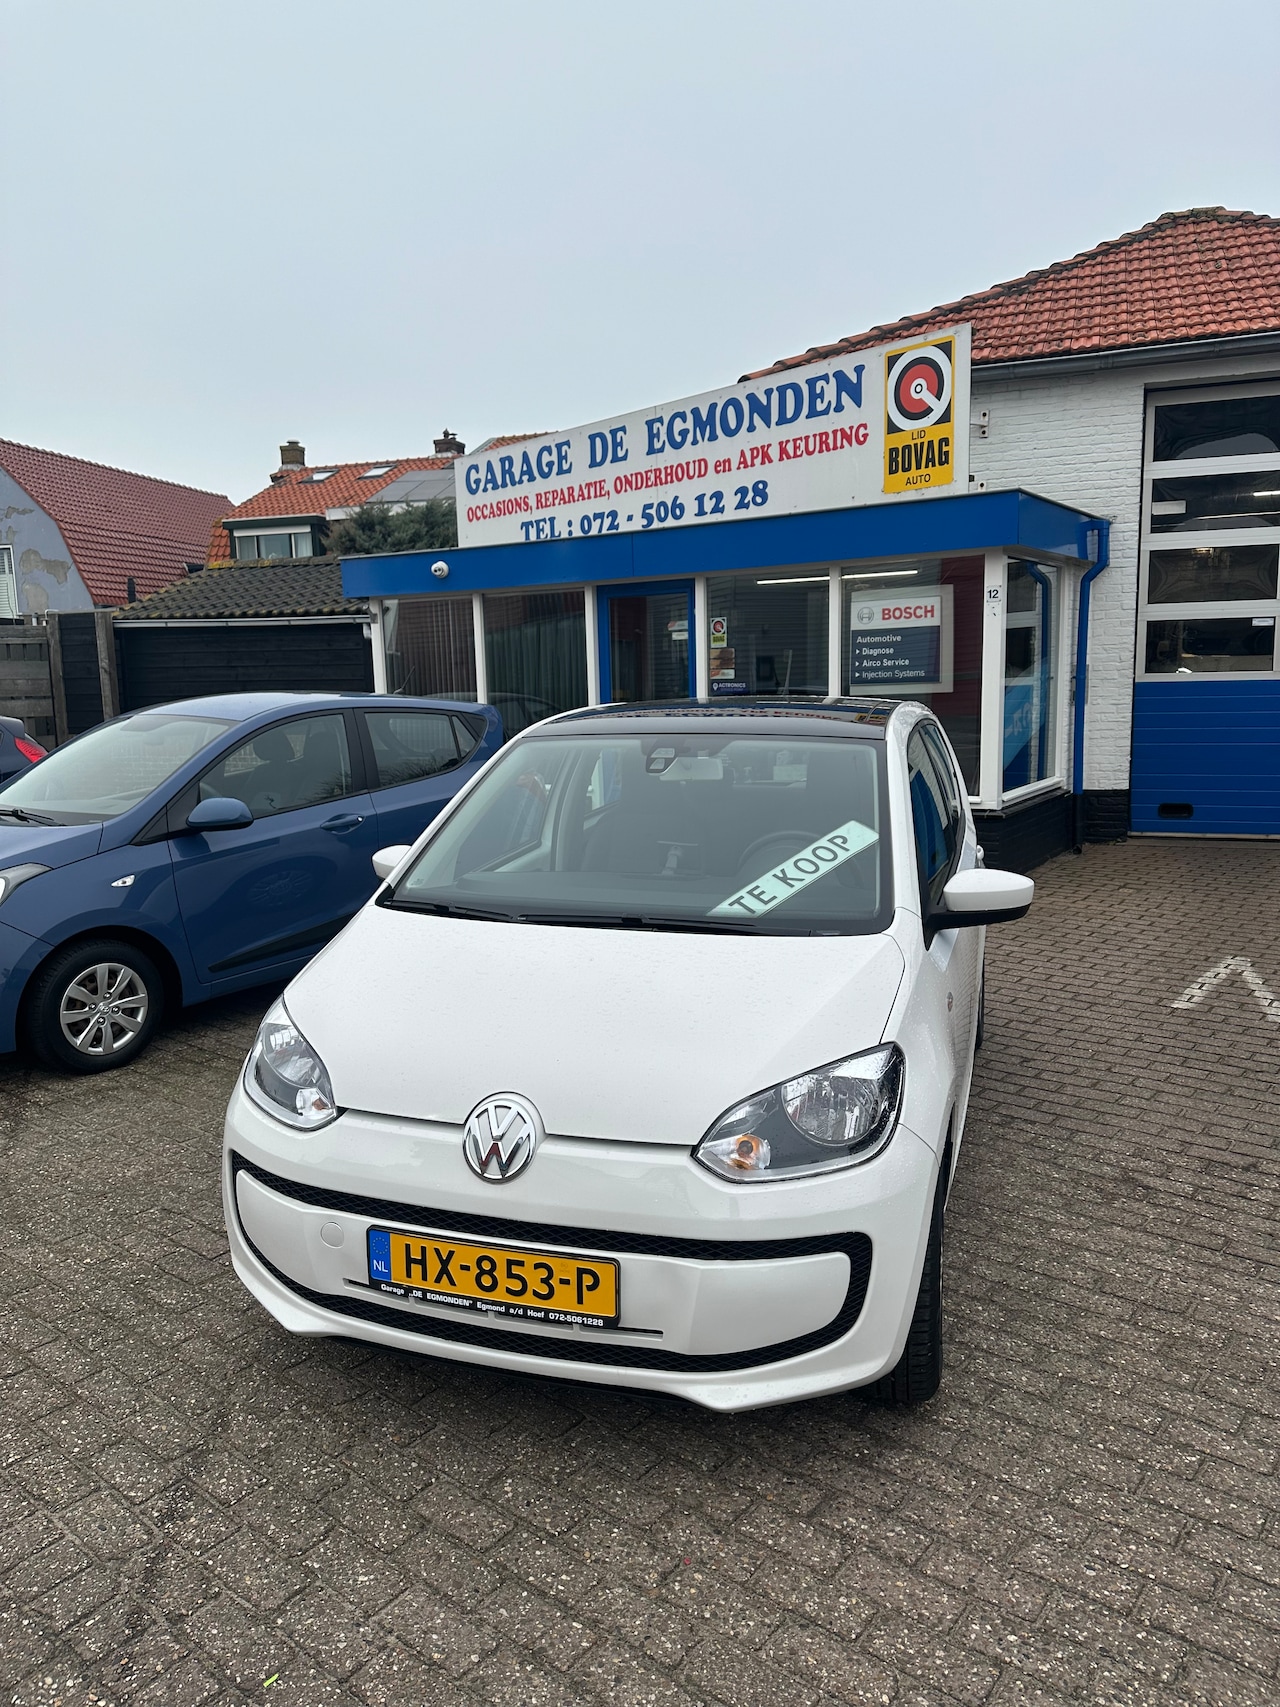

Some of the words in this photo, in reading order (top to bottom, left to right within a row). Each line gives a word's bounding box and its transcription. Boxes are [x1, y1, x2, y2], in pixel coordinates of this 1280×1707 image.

[465, 440, 573, 496] GARAGE
[588, 425, 629, 469] DE
[645, 364, 865, 456] EGMONDEN
[911, 429, 927, 441] LID
[888, 436, 950, 476] BOVAG
[467, 495, 533, 523] OCCASIONS,
[535, 479, 611, 510] REPARATIE,
[613, 458, 708, 495] ONDERHOUD
[714, 457, 732, 475] en
[736, 443, 774, 471] APK
[778, 423, 869, 462] KEURING
[905, 473, 932, 487] AUTO
[580, 510, 620, 535] 072
[641, 495, 685, 529] 506
[694, 490, 725, 517] 12
[734, 480, 769, 510] 28
[987, 589, 999, 599] 12
[881, 604, 935, 621] BOSCH
[856, 634, 902, 643] Automotive
[862, 647, 894, 656] Diagnose
[862, 659, 881, 667] Airco
[882, 658, 909, 666] Service
[862, 671, 893, 680] Injection
[894, 669, 925, 678] Systems
[728, 885, 778, 915] TE
[772, 834, 850, 889] KOOP
[373, 1259, 389, 1273] NL
[404, 1242, 600, 1305] HX-853-P
[380, 1283, 405, 1295] Garage
[476, 1301, 506, 1313] Egmond
[527, 1309, 545, 1318] Hoef
[548, 1312, 604, 1326] 072-5061228
